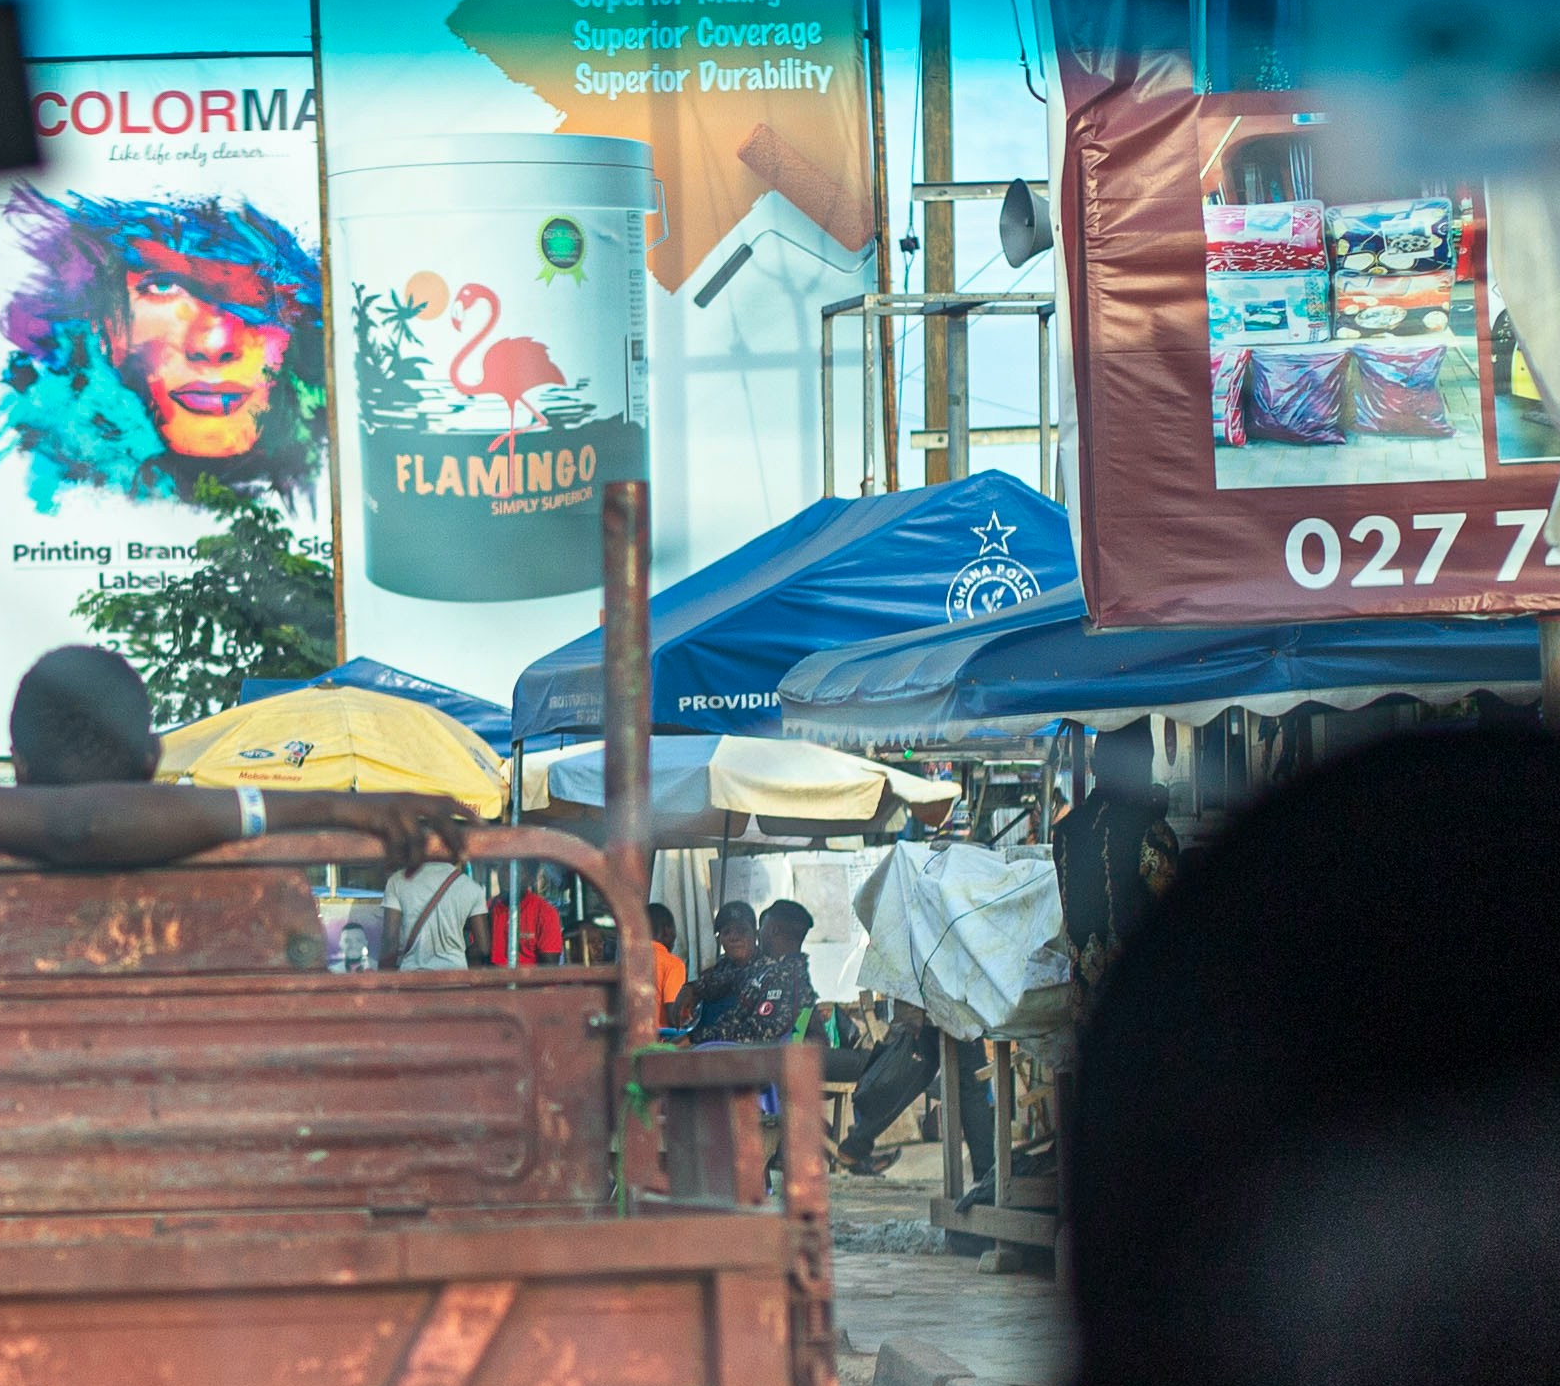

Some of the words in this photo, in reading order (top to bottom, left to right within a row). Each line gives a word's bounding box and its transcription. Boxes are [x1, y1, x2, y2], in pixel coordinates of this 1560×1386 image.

[573, 18, 689, 56] Superior
[696, 15, 822, 50] Coverage
[574, 62, 690, 99] Superior
[698, 58, 834, 93] Durability
[109, 144, 140, 161] Like
[144, 143, 172, 165] life
[175, 142, 208, 167] only
[396, 443, 597, 498] FLAMINGO
[491, 497, 539, 516] SIMPLY
[541, 487, 594, 512] SUPERIOR
[12, 540, 112, 564] Printing
[1285, 511, 1467, 590] 027
[98, 571, 179, 590] Labels
[953, 564, 992, 610] GHANA
